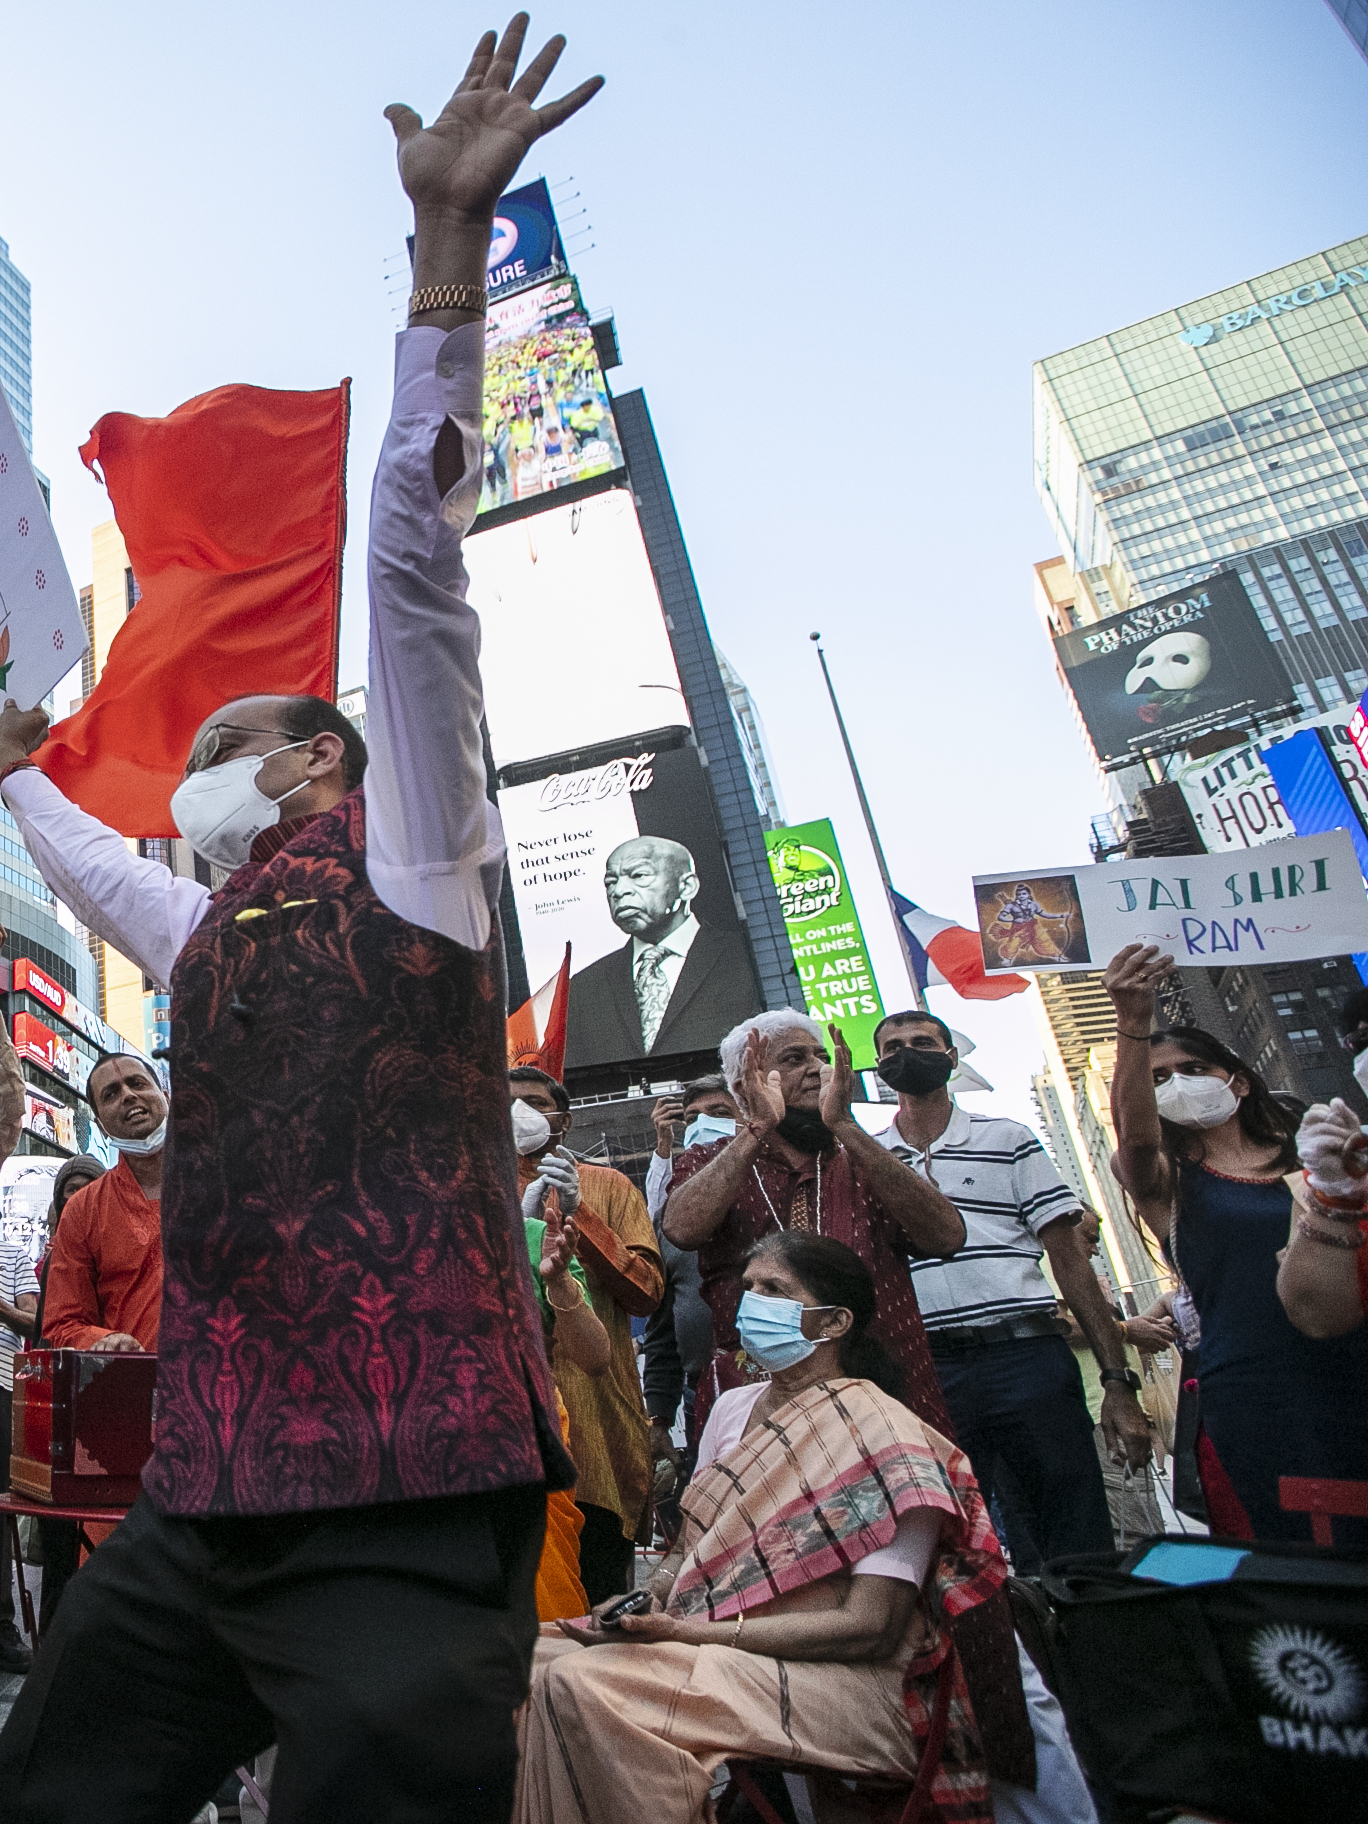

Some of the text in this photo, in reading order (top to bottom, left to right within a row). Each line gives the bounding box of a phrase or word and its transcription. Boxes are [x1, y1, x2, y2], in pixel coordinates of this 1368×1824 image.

[1083, 592, 1213, 652] PHANTOM
[1126, 603, 1159, 622] THE
[1100, 610, 1206, 655] OF THE OPERA
[517, 829, 594, 853] Never lose
[520, 847, 596, 870] that sense
[523, 868, 586, 887] of hope.
[777, 874, 835, 898] reen
[1107, 857, 1331, 913] JAI SHRI
[534, 895, 581, 912] John Lewis
[789, 921, 856, 945] LL ON THE
[1181, 917, 1266, 955] RAM
[792, 937, 861, 960] NTLINES,
[821, 955, 866, 979] ARE
[29, 969, 62, 1007] USD/AUD
[815, 974, 872, 1001] TRUE
[809, 994, 878, 1022] ANTS
